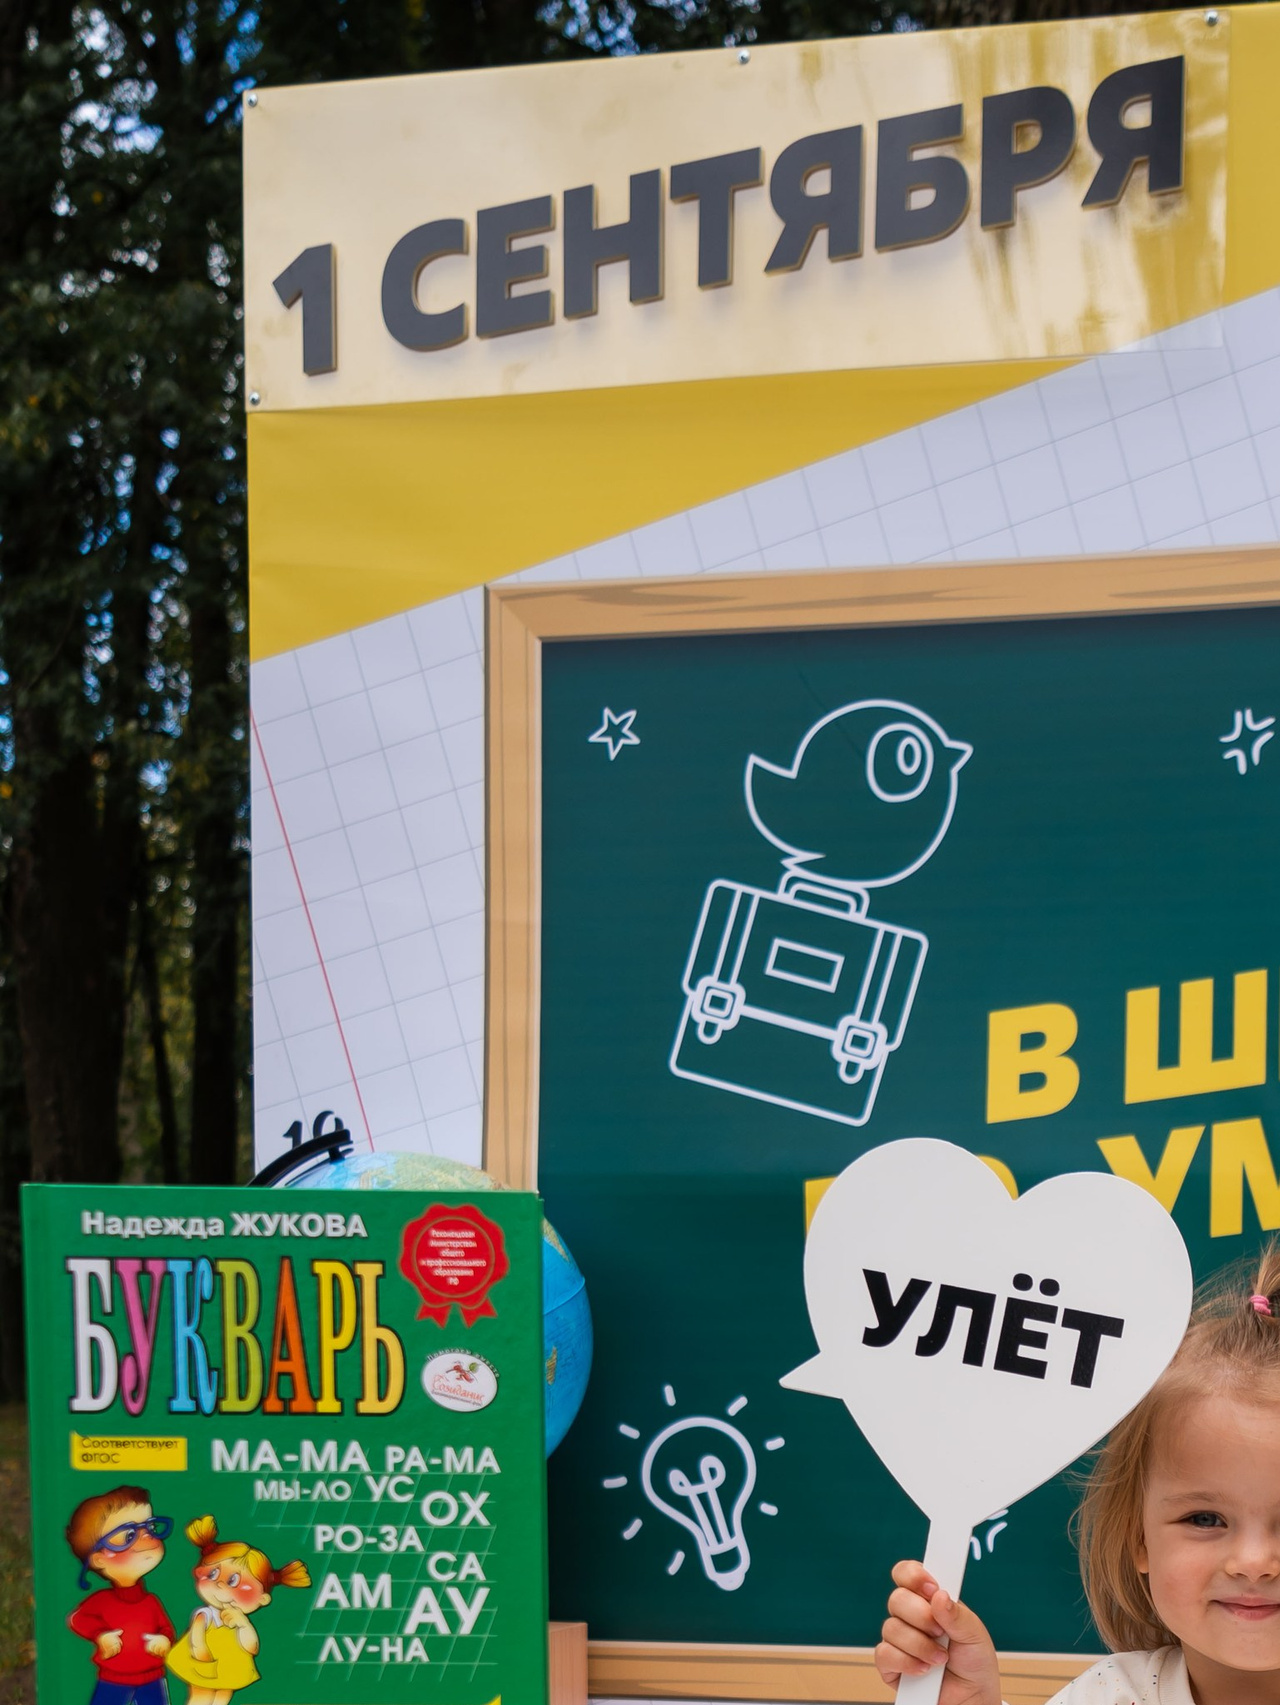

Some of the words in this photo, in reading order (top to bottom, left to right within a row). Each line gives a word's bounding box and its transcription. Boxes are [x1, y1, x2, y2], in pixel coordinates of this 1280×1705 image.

[271, 242, 339, 377] 1
[380, 54, 1187, 353] СЕНТЯБРЯ
[986, 1003, 1081, 1123] В
[80, 1210, 225, 1239] Надежда
[229, 1212, 368, 1238] ЖУКОВА
[66, 1256, 406, 1417] БУКВАРЬ
[861, 1268, 1126, 1389] УЛЁТ
[80, 1451, 121, 1465] ФГОС
[81, 1436, 180, 1452] Соответствует
[211, 1438, 372, 1473] МА-МА
[385, 1445, 502, 1474] РА-МА
[254, 1480, 353, 1501] МЫ-ЛО
[364, 1475, 415, 1503] УС
[420, 1491, 491, 1527] ОХ
[314, 1524, 425, 1552] РО-ЗА
[427, 1552, 487, 1581] СА
[313, 1573, 393, 1609] АМ
[403, 1587, 491, 1635] АУ
[319, 1636, 430, 1663] ЛУ-НА
